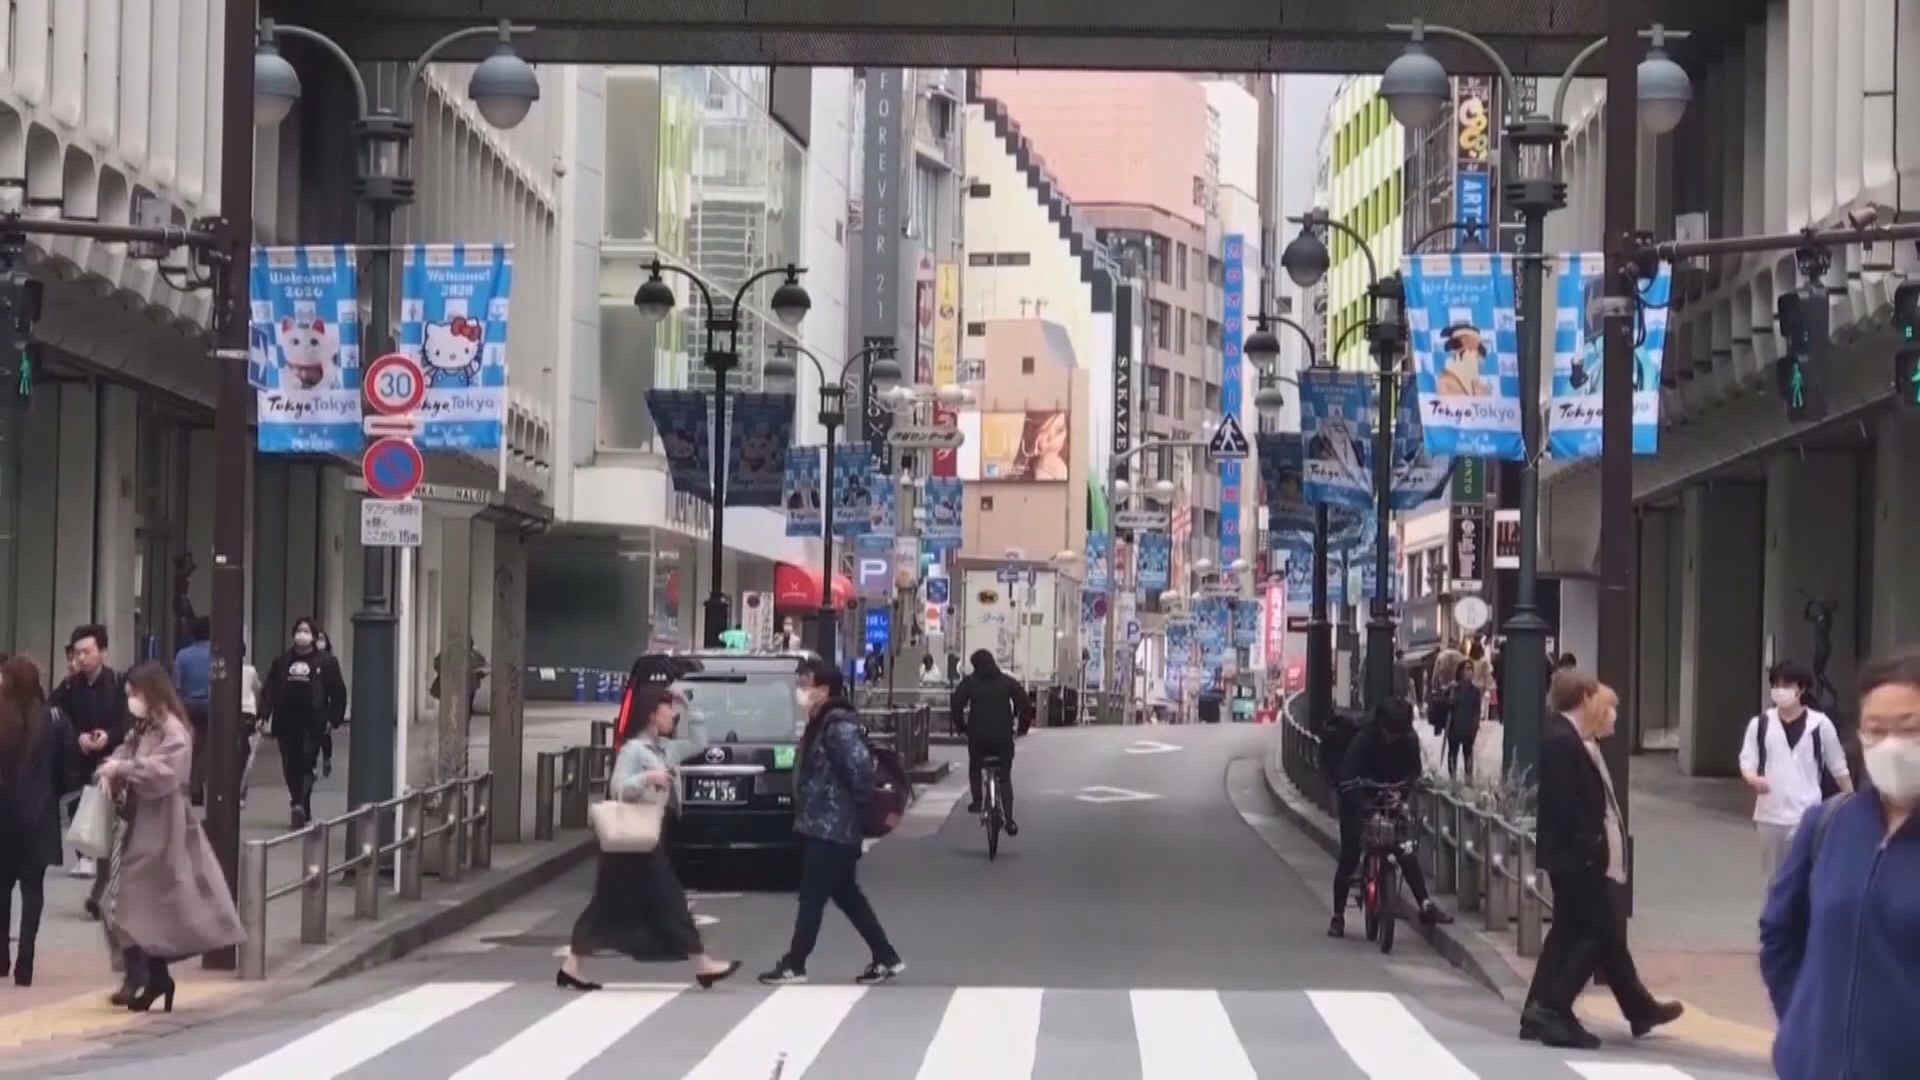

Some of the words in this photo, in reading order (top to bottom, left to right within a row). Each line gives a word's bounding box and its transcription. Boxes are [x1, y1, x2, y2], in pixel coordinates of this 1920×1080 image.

[876, 71, 889, 254] FOREVER
[270, 271, 337, 284] Welcome!
[875, 274, 886, 319] 21
[379, 373, 412, 397] 30
[267, 395, 311, 419] Tokyo
[313, 395, 357, 414] Tokyo
[1115, 355, 1129, 456] SAKAZE
[1430, 400, 1472, 424] Tokyo
[1474, 403, 1515, 424] Tokyo
[399, 530, 419, 543] 15m
[860, 559, 887, 585] P
